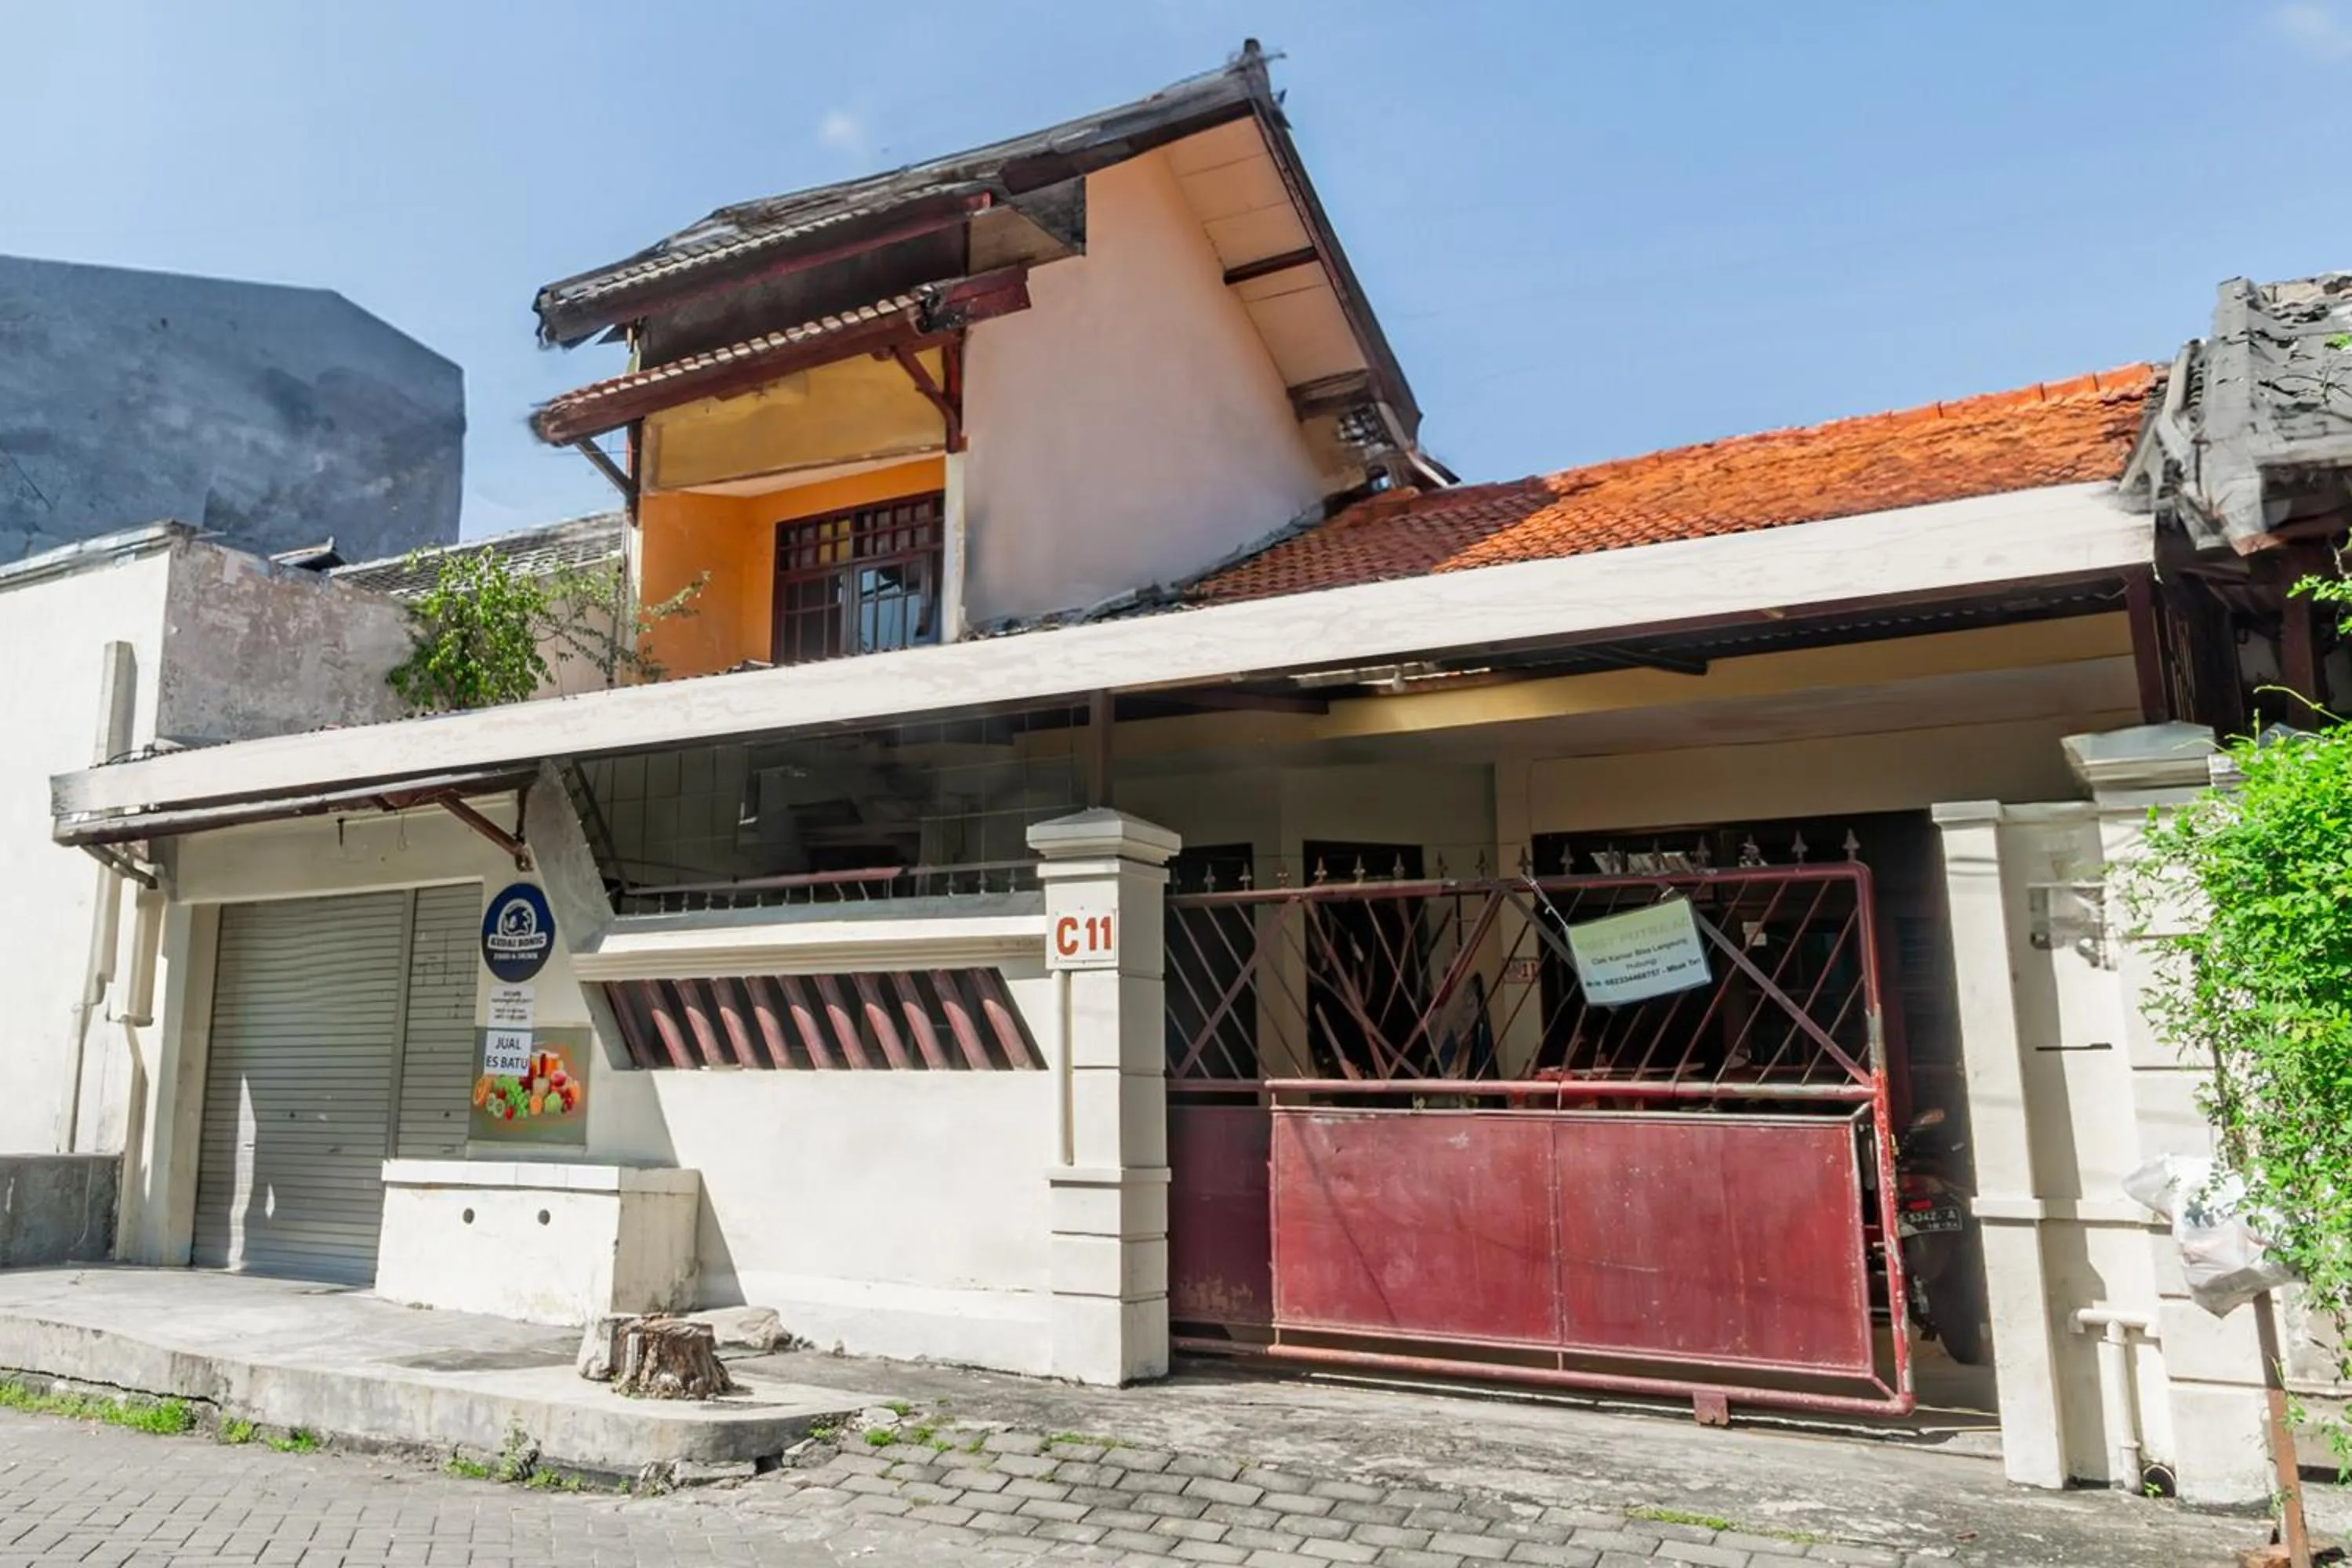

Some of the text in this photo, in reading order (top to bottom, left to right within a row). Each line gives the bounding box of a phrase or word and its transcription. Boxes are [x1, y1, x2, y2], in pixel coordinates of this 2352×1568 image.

[495, 1037, 521, 1050] JUAL
[486, 1054, 528, 1069] ES BATU
